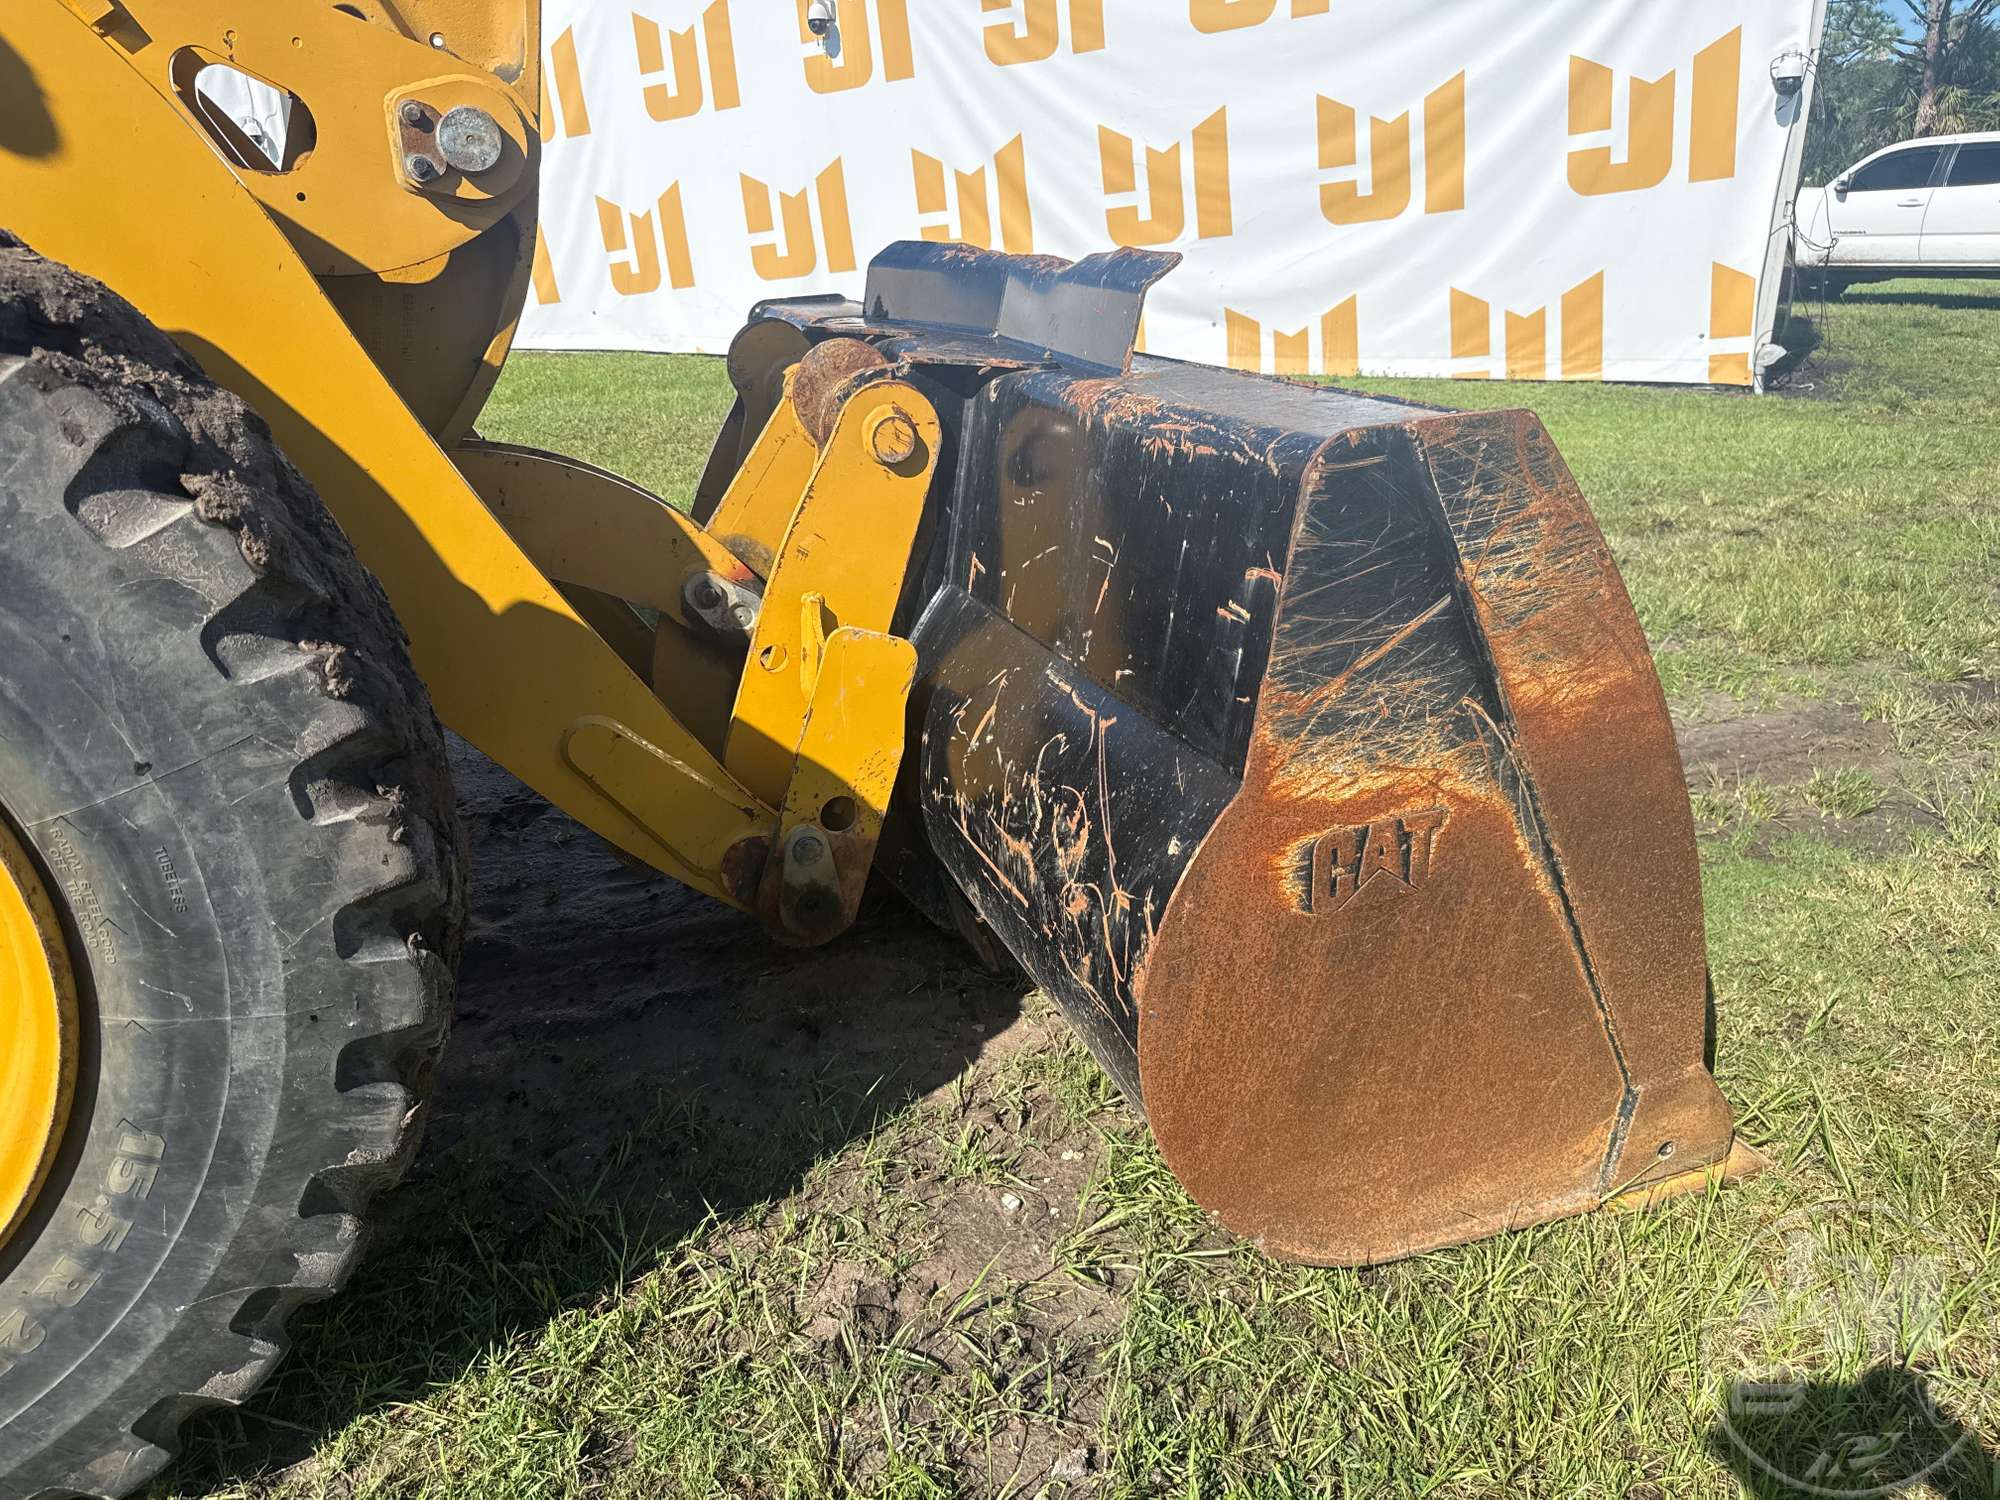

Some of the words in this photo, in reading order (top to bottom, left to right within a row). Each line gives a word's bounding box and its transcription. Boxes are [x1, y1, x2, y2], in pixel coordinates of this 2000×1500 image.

[49, 827, 84, 875] RADIAL
[80, 879, 104, 923] STEEL
[97, 926, 118, 966] CORD
[49, 847, 71, 873] OFF
[65, 879, 84, 905] THE
[79, 911, 99, 949] ROAD
[154, 845, 188, 914] TUBELESS
[1306, 808, 1449, 916] CAT
